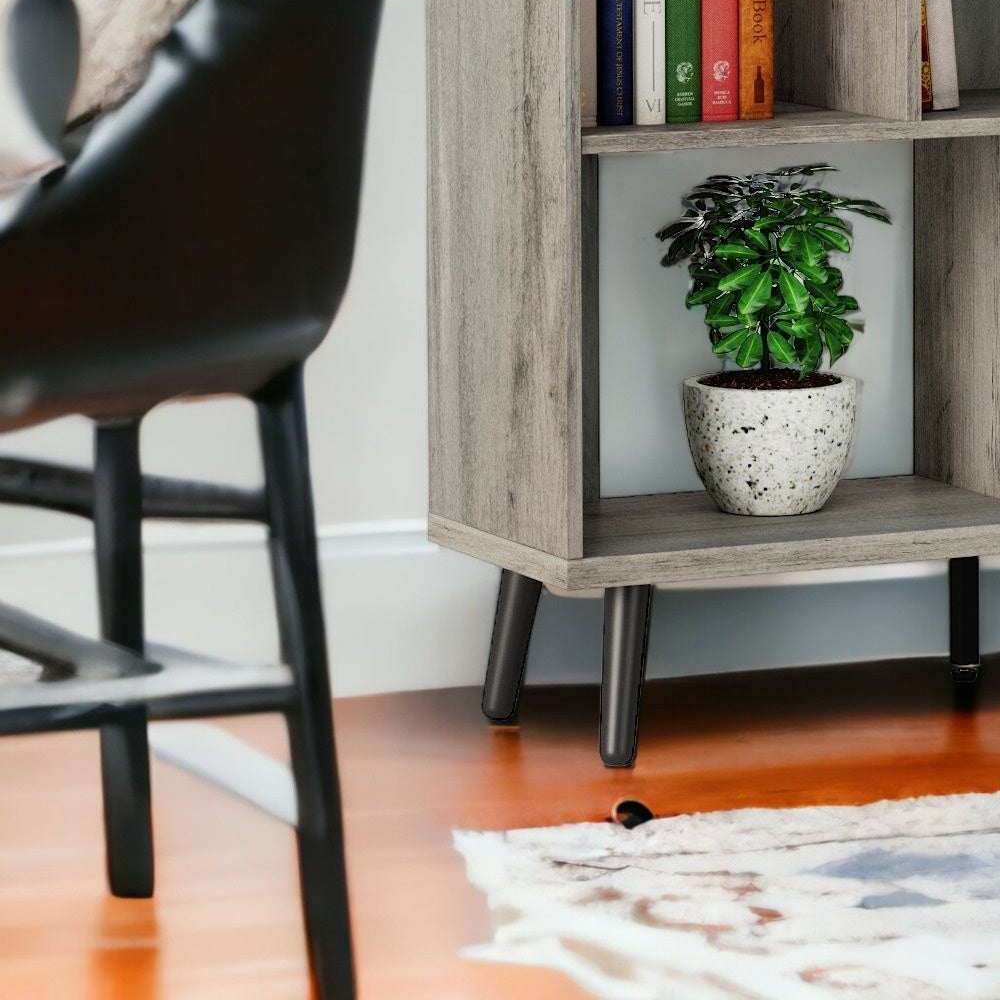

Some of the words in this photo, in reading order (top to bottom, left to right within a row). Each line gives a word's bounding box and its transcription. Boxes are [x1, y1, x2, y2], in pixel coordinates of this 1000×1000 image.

[615, 3, 623, 49] TESTAMENT
[752, 0, 767, 43] Book
[615, 63, 623, 87] JESUS
[615, 87, 623, 116] CHRIST
[645, 98, 661, 113] VI
